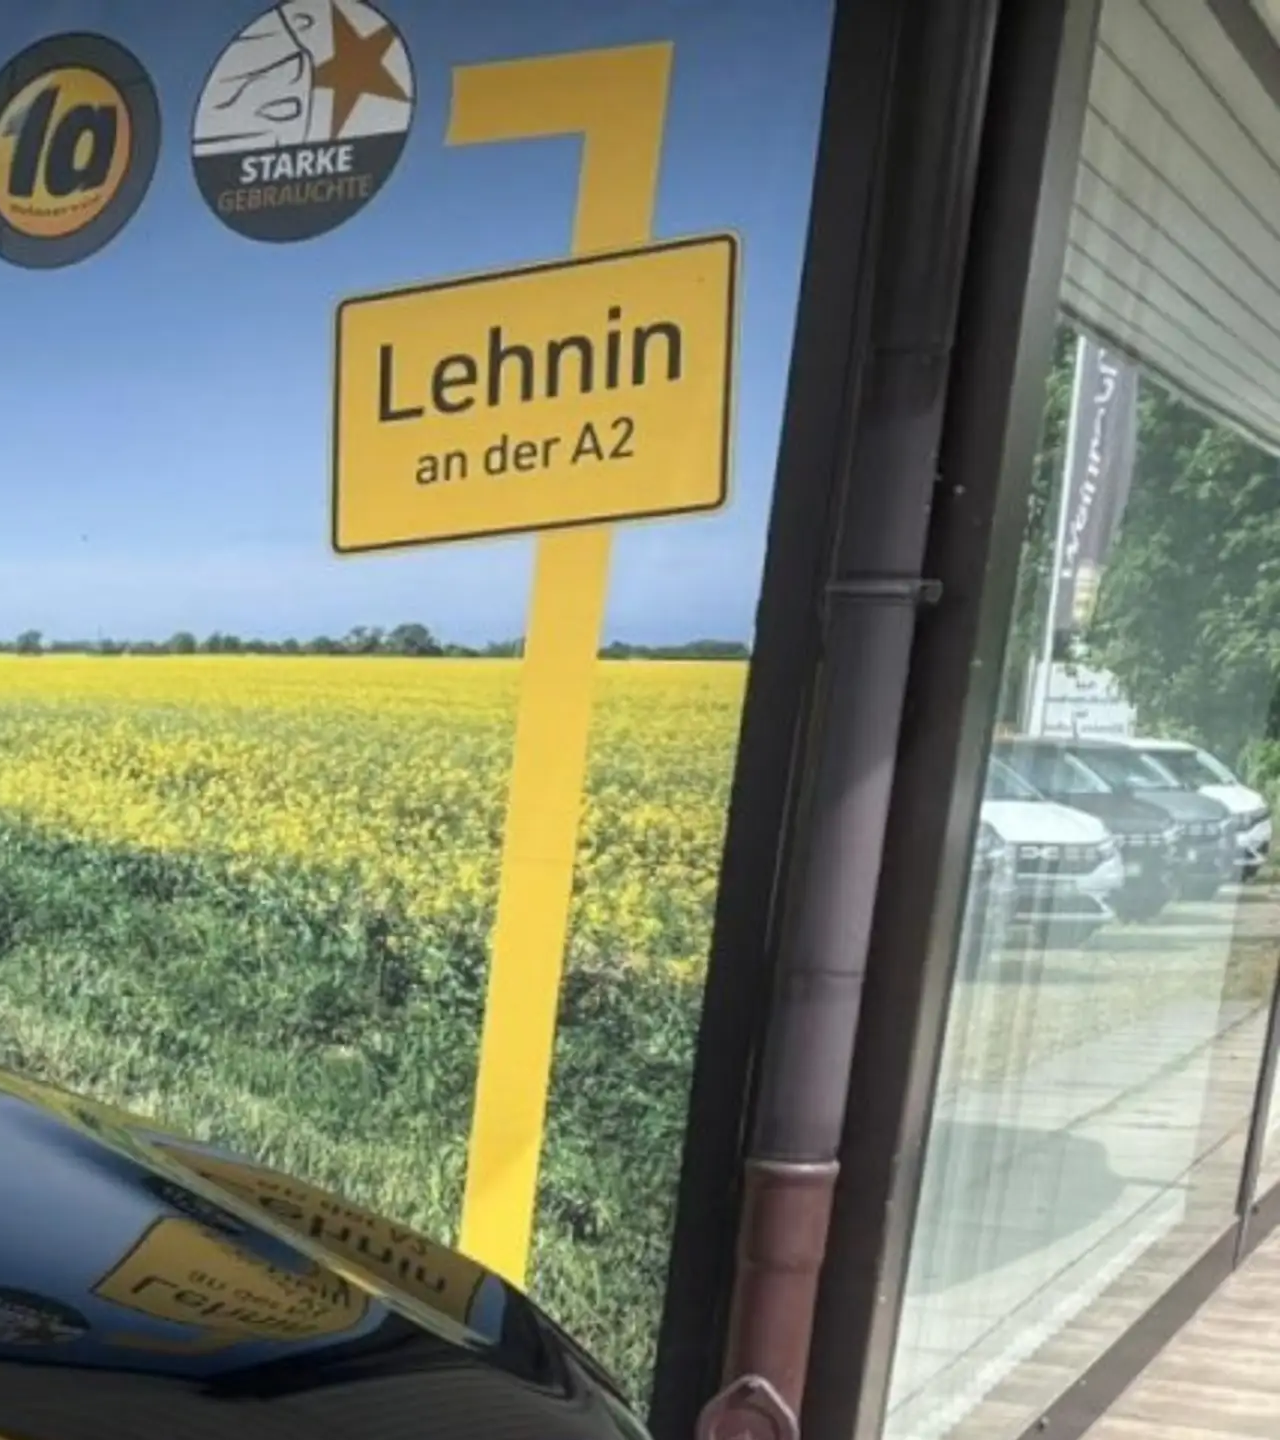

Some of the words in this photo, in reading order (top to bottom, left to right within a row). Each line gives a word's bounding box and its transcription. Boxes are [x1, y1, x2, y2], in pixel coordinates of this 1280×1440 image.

[240, 145, 354, 185] STARKE
[217, 173, 373, 215] GEBRAUCHTE
[378, 305, 682, 423] Lehnin
[415, 448, 468, 485] an
[484, 433, 561, 476] der
[570, 415, 635, 464] A2
